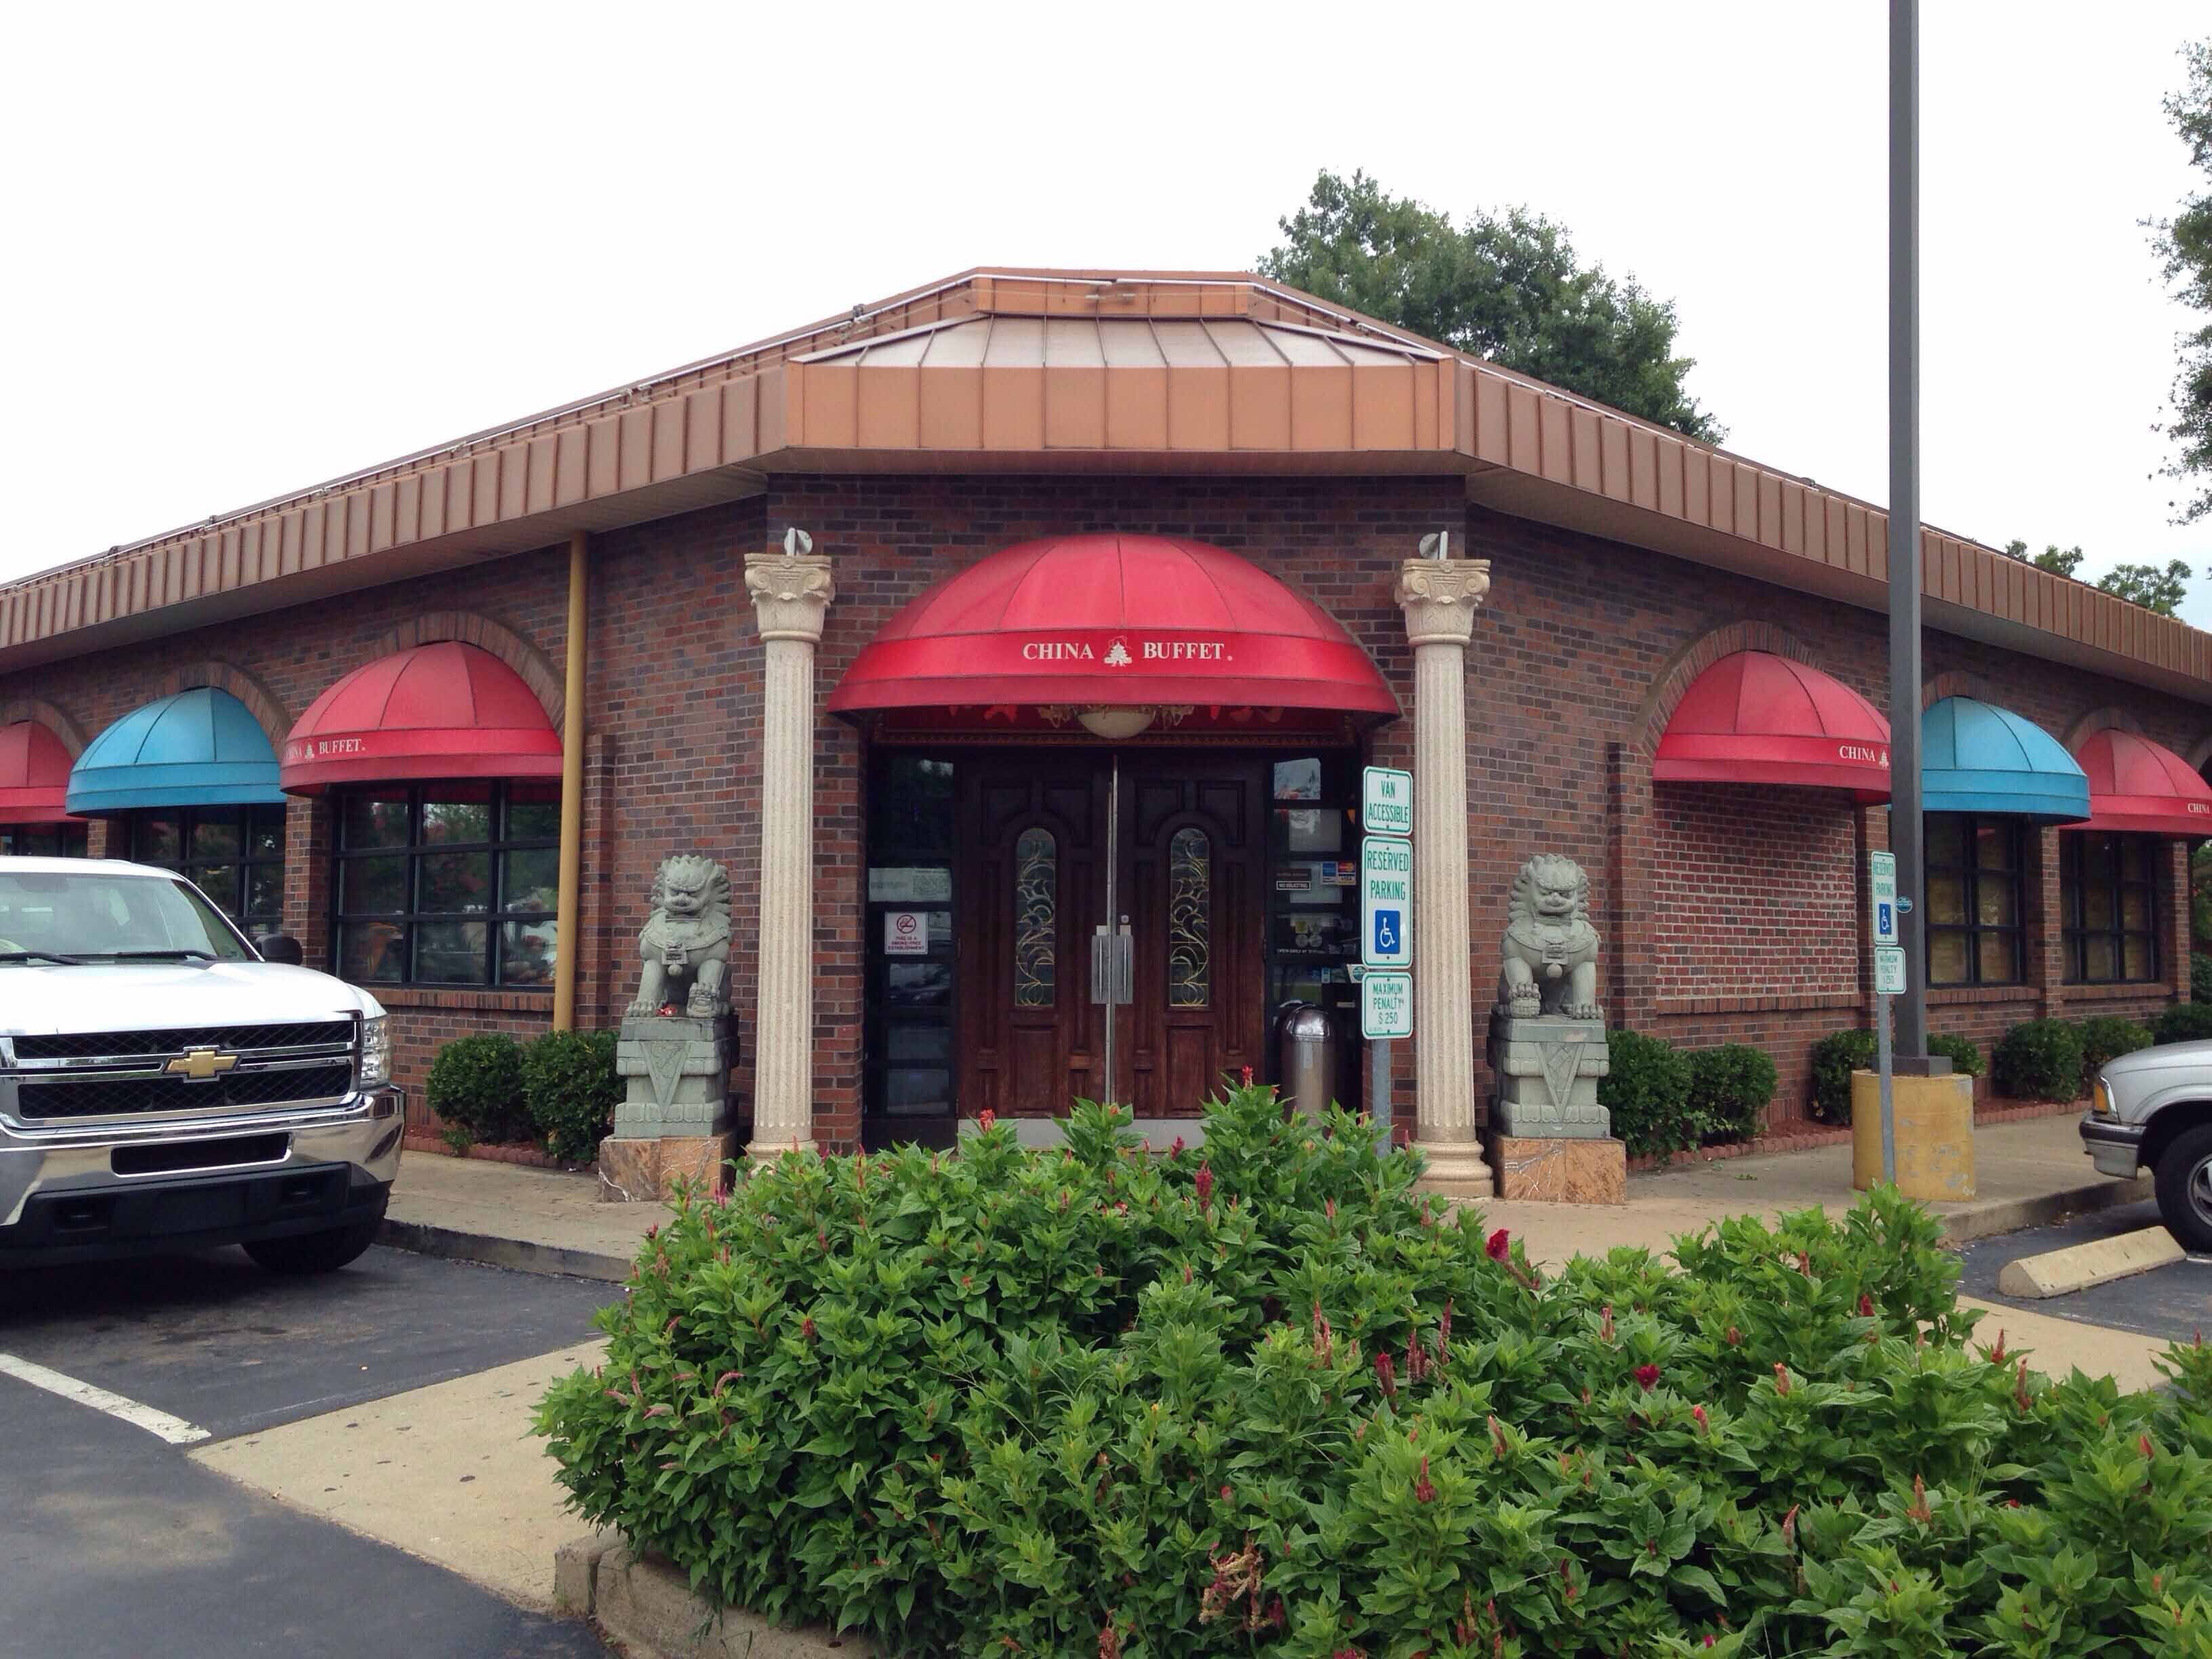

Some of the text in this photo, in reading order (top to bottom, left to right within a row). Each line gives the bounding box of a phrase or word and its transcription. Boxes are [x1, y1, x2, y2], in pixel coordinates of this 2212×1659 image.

[1022, 642, 1094, 660] CHINA
[1839, 745, 1876, 762] CHINA
[1380, 780, 1396, 798] VAN
[1368, 802, 1409, 823] ACCESSIBLE
[2187, 802, 2210, 814] CHINA
[1367, 851, 1409, 872] RESERVED
[1370, 880, 1406, 901] PARKING
[1373, 983, 1404, 994] MAXIMUM
